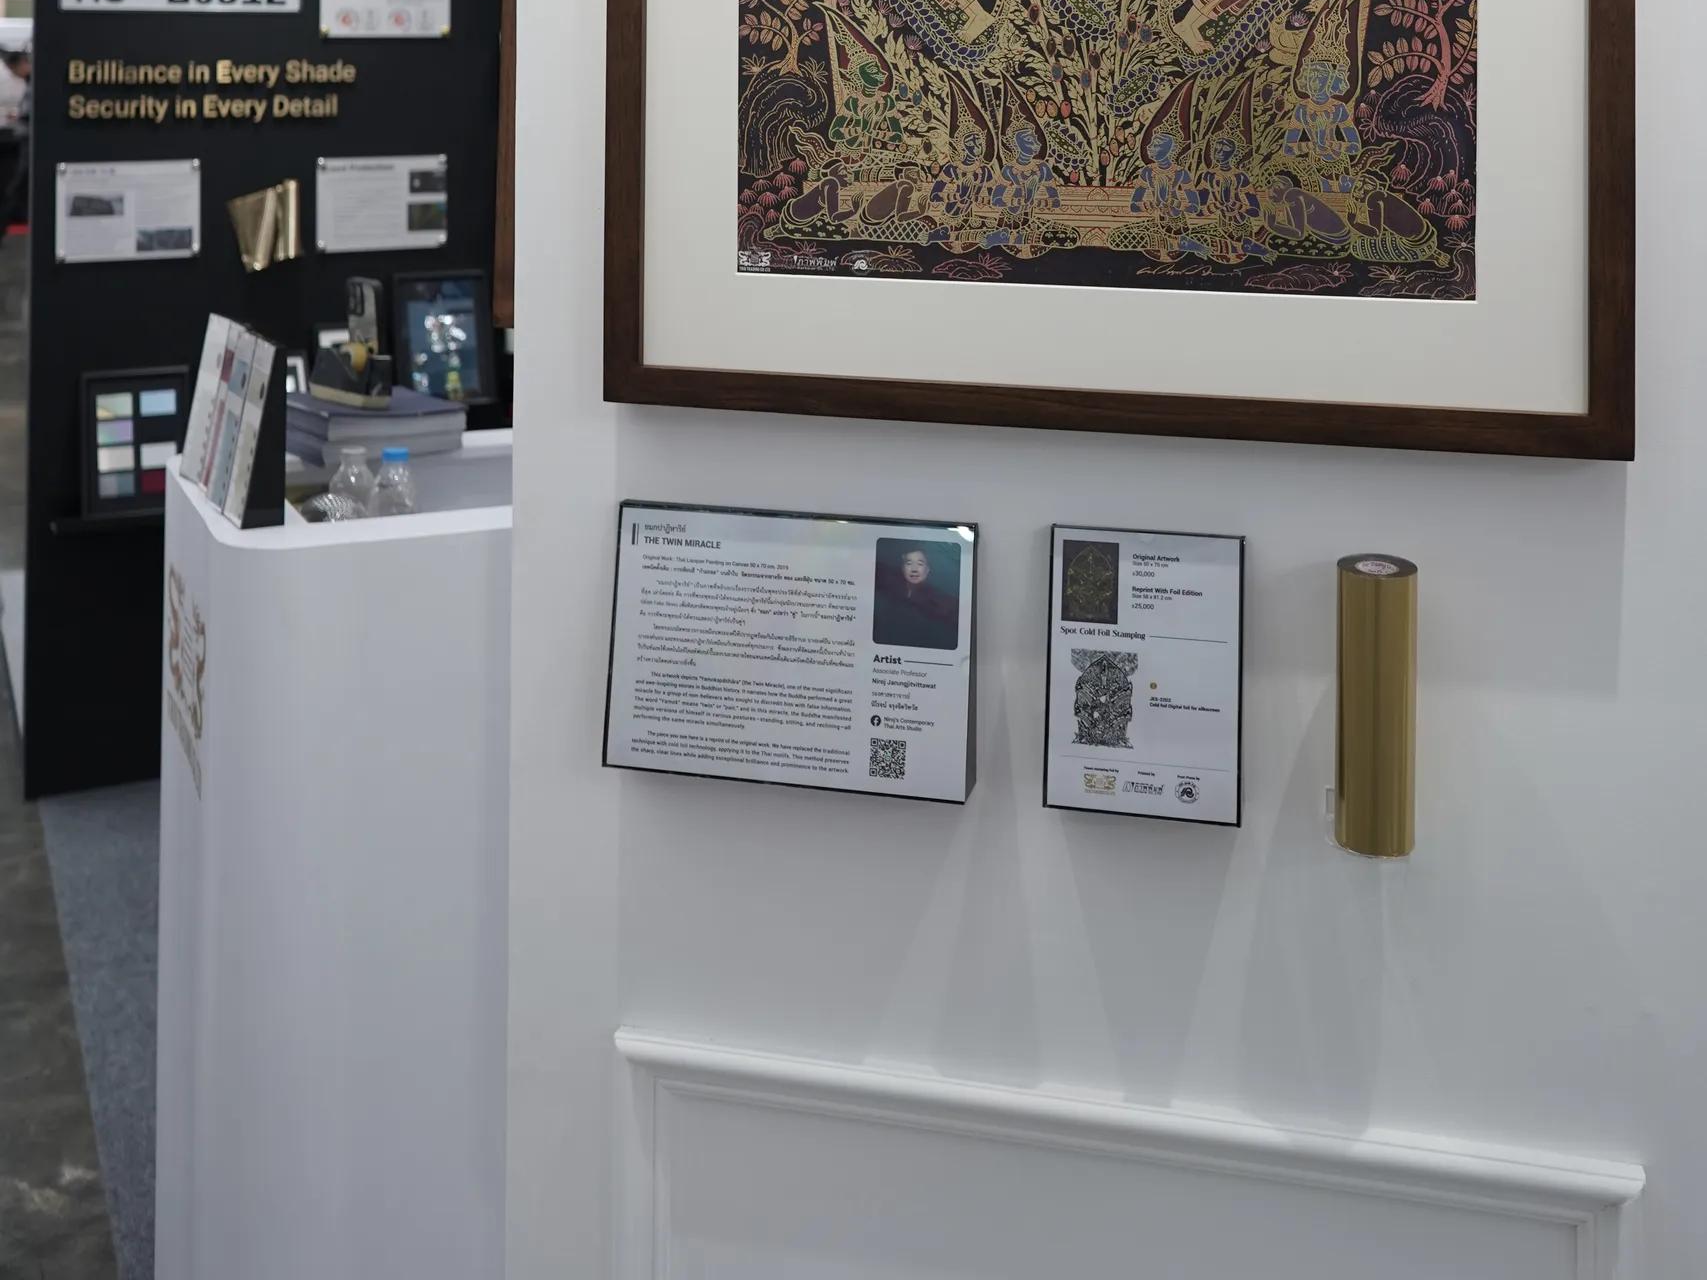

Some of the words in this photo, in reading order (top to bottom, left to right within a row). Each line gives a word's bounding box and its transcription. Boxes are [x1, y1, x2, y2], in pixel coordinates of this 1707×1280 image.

[68, 60, 182, 84] Brilliance
[188, 61, 210, 84] in
[216, 60, 280, 88] Every
[285, 60, 356, 84] Shade
[68, 94, 168, 123] Security
[175, 95, 196, 118] in
[203, 94, 267, 123] Every
[273, 94, 338, 118] Detail
[644, 536, 660, 544] THE
[662, 538, 682, 546] TWIN
[685, 539, 721, 549] MIRACLE
[1060, 626, 1077, 635] Spot
[1079, 628, 1095, 636] Cold
[1112, 630, 1146, 641] Stamping
[873, 654, 902, 664] Artist
[900, 718, 934, 727] Contemporary
